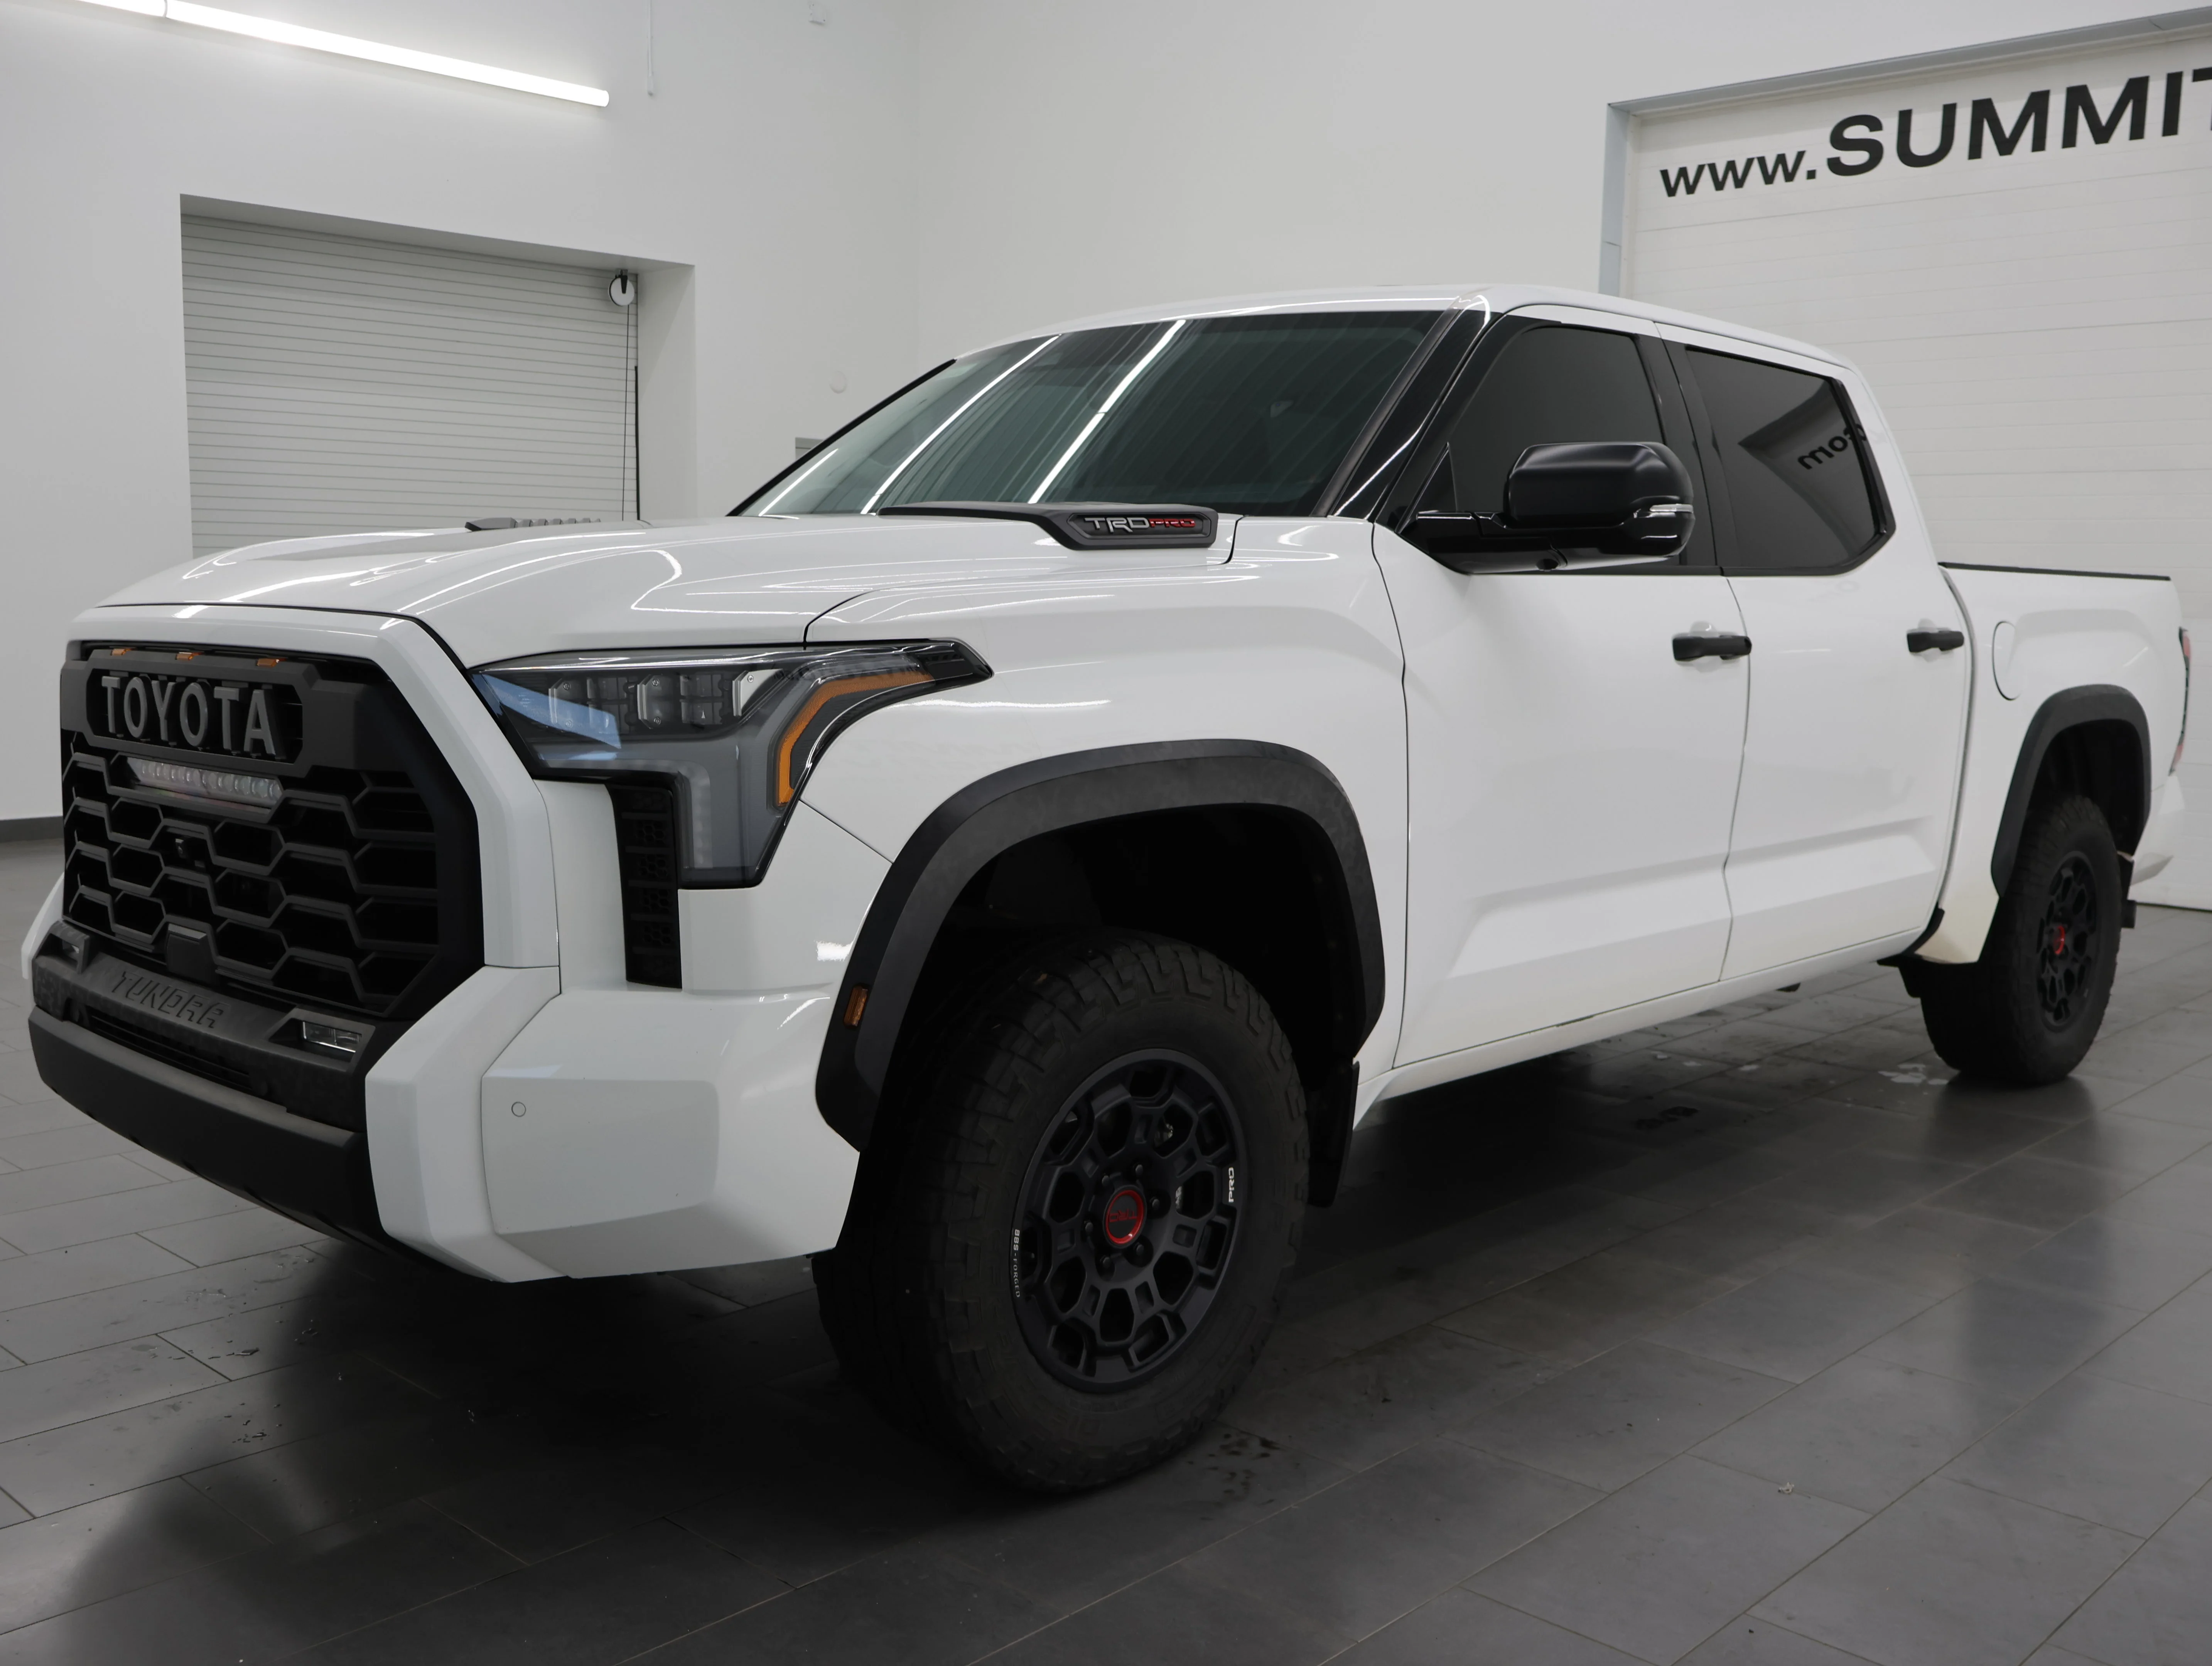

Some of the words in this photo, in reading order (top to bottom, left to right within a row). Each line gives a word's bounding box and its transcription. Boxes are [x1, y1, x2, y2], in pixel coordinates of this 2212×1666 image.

[1084, 516, 1149, 533] TRD
[1149, 518, 1196, 528] PRO
[101, 675, 277, 757] TOYOTA
[111, 971, 231, 1029] TUNDRA
